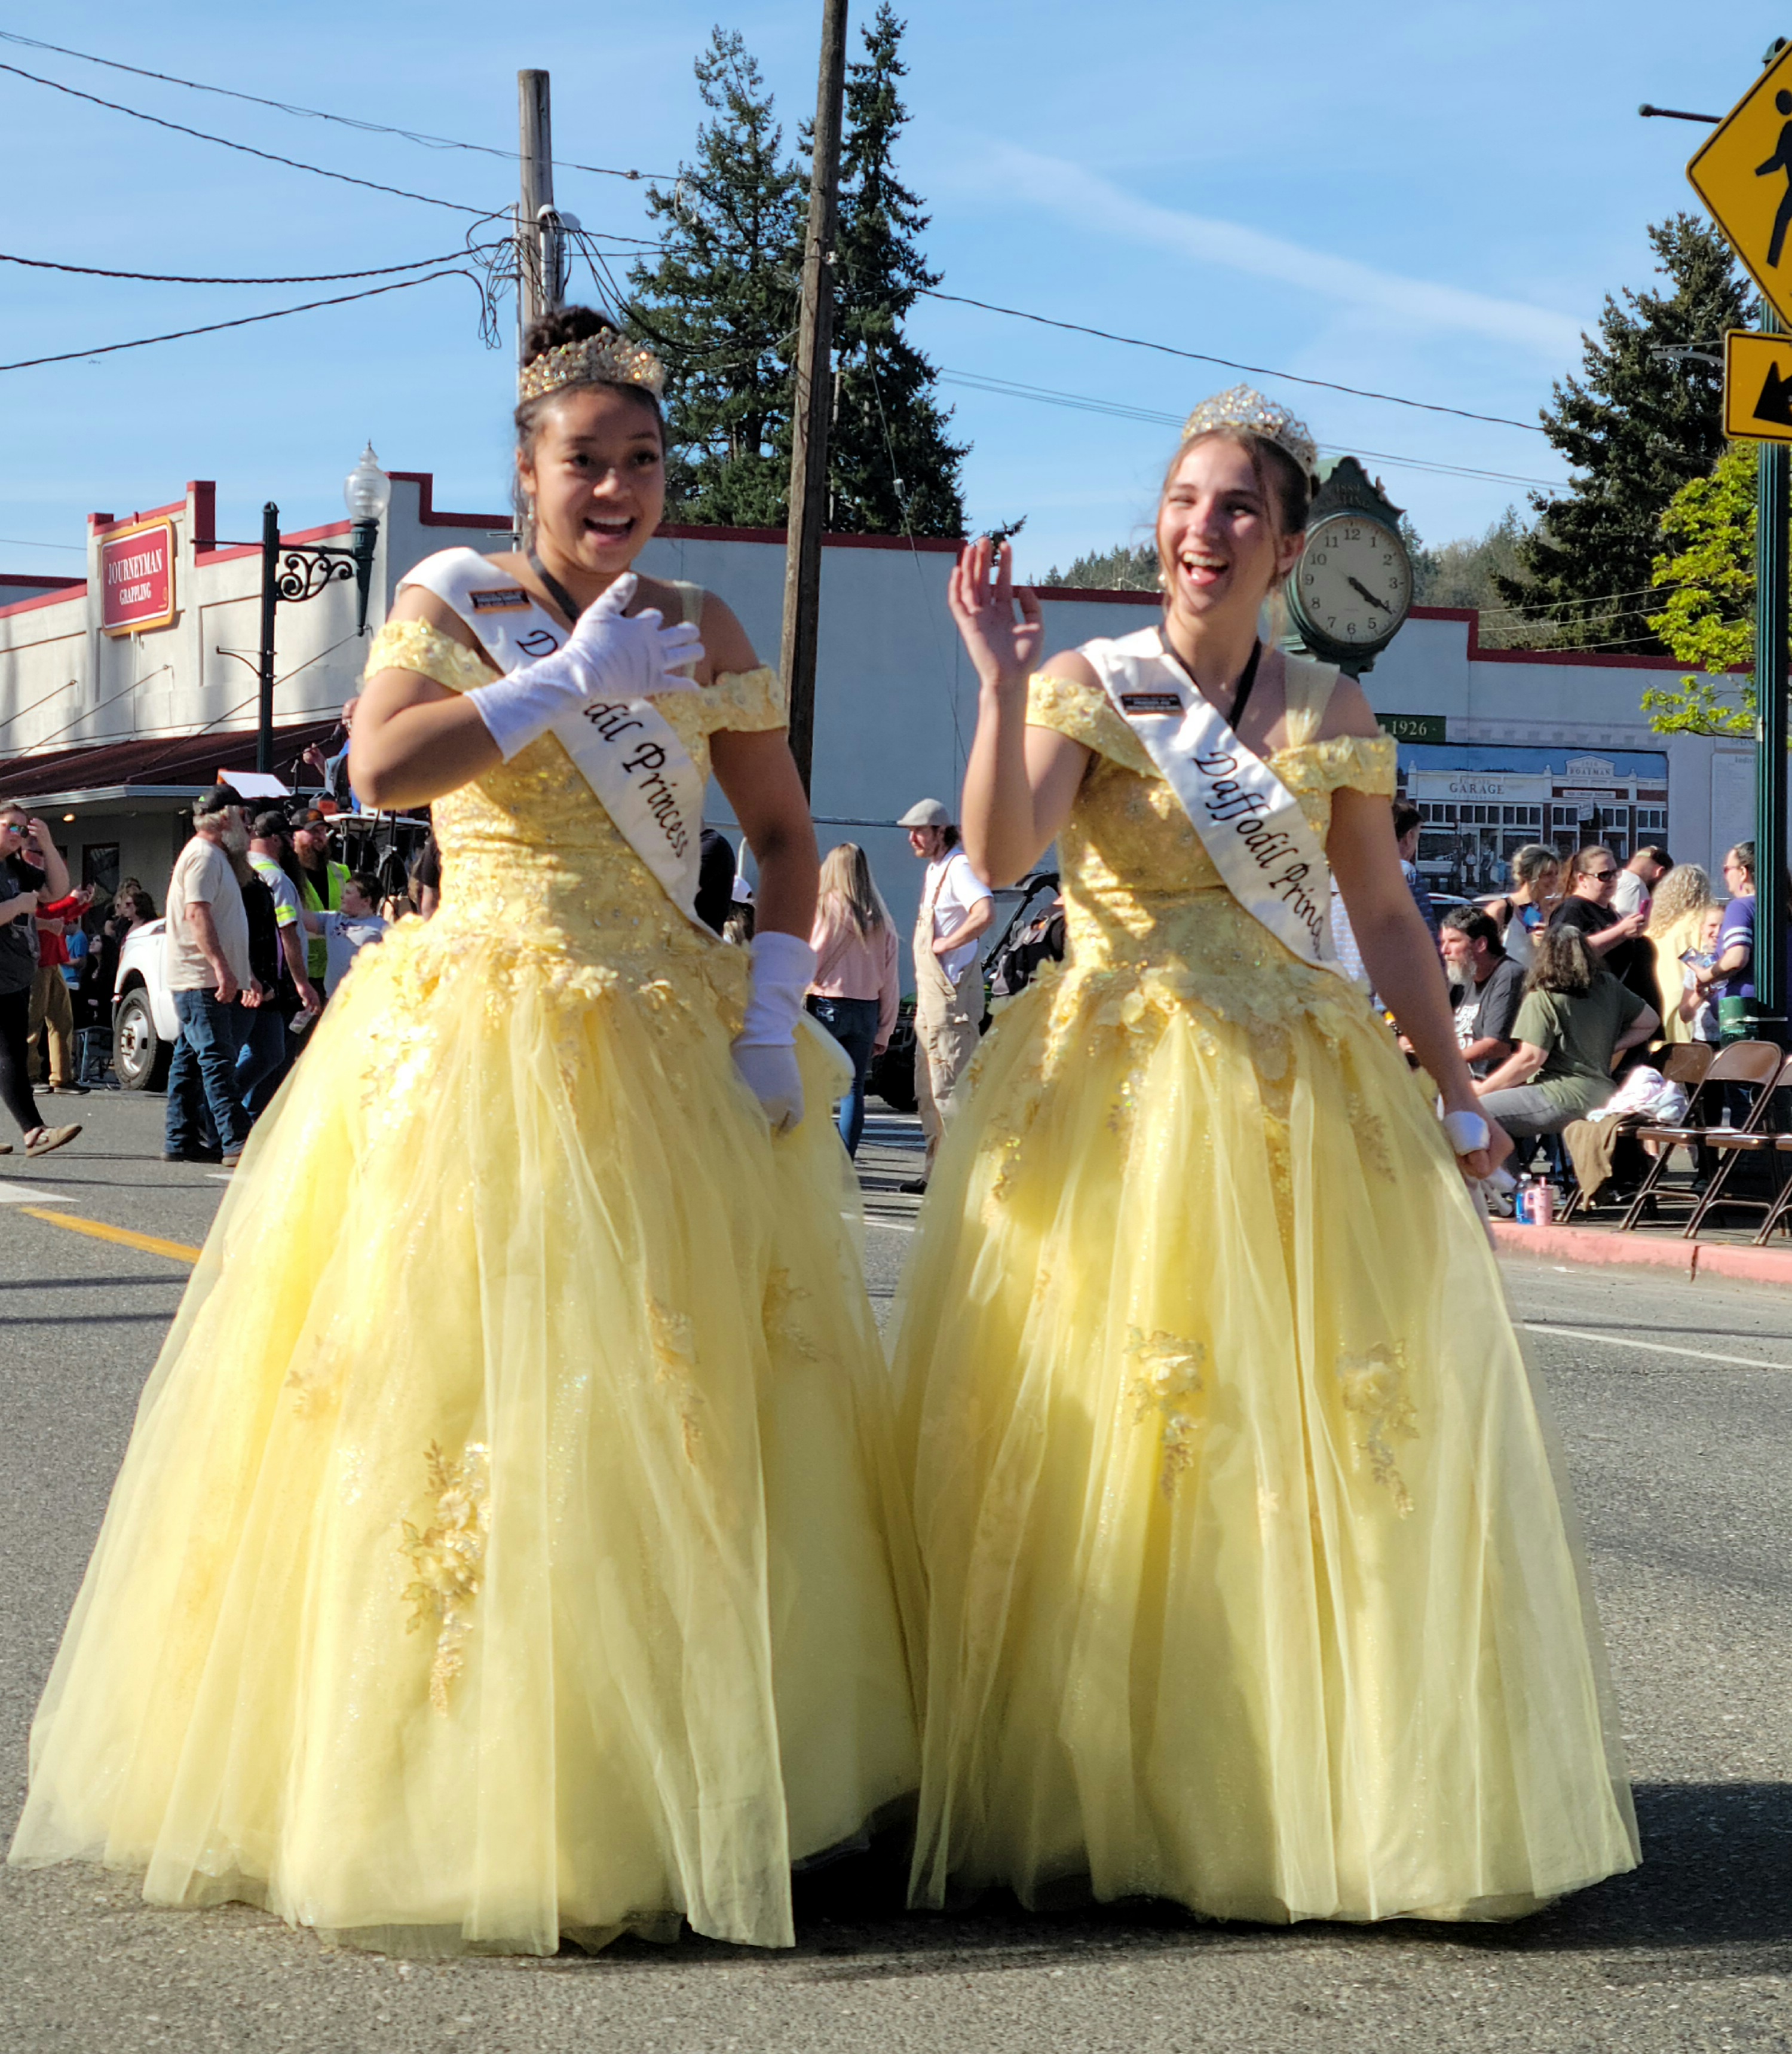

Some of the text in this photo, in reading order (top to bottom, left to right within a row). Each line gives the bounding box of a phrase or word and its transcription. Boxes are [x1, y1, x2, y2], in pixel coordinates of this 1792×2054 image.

[1344, 528, 1361, 541] 12
[1325, 536, 1339, 548] 11
[1370, 536, 1377, 548] 1
[1310, 553, 1327, 565] 10
[1383, 554, 1392, 566] 2
[108, 548, 163, 586] JOURNEYMAN
[1304, 574, 1314, 586] 9
[1389, 577, 1398, 589] 3
[120, 581, 151, 605] GRAPPLING
[1311, 597, 1321, 609] 8
[1327, 616, 1337, 628] 7
[1368, 617, 1377, 629] 5
[1346, 622, 1356, 635] 6
[1392, 721, 1428, 736] 1926
[1449, 782, 1505, 794] GARAGE
[622, 743, 689, 858] Princess
[1191, 751, 1299, 868] Daffodil
